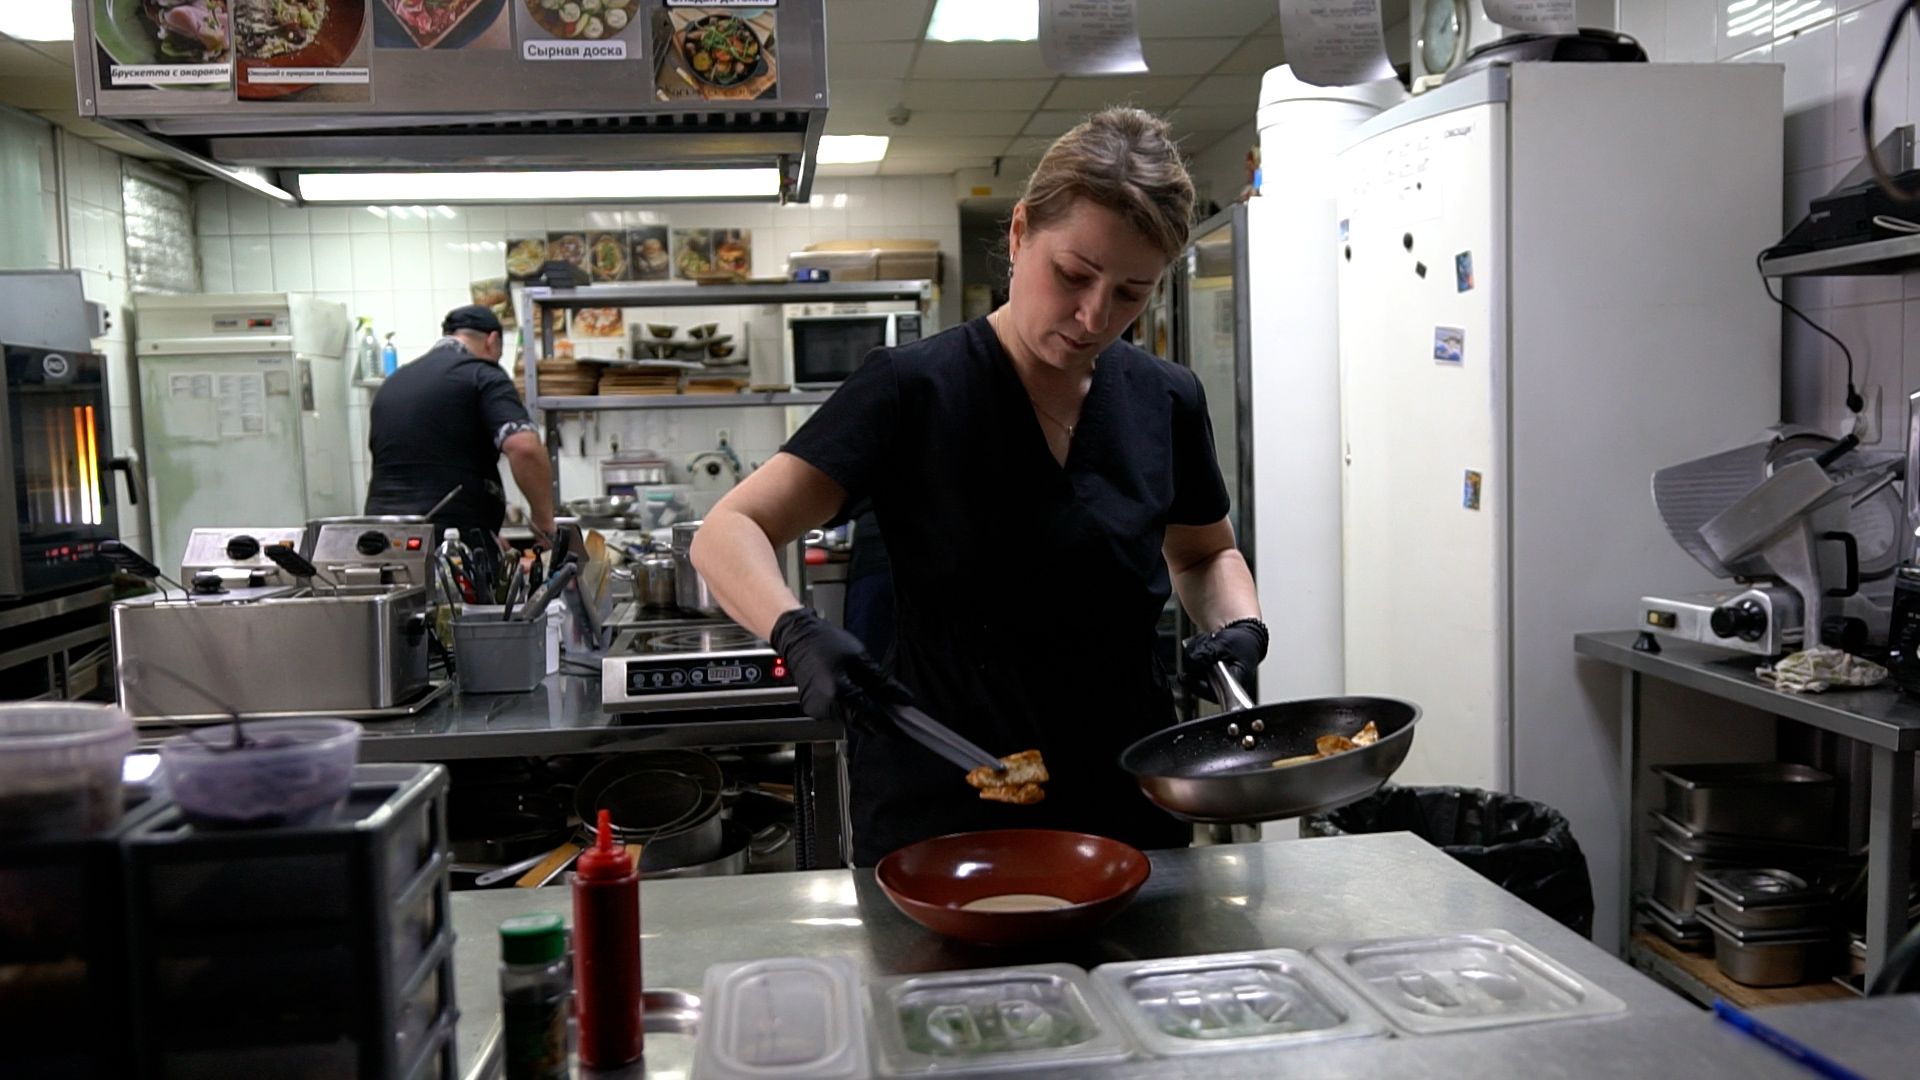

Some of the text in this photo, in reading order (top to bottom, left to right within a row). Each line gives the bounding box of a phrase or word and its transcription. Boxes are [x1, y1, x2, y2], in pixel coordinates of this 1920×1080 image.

[527, 44, 623, 58] Сырная доска
[112, 68, 170, 78] Брускетта
[180, 68, 228, 78] окороком
